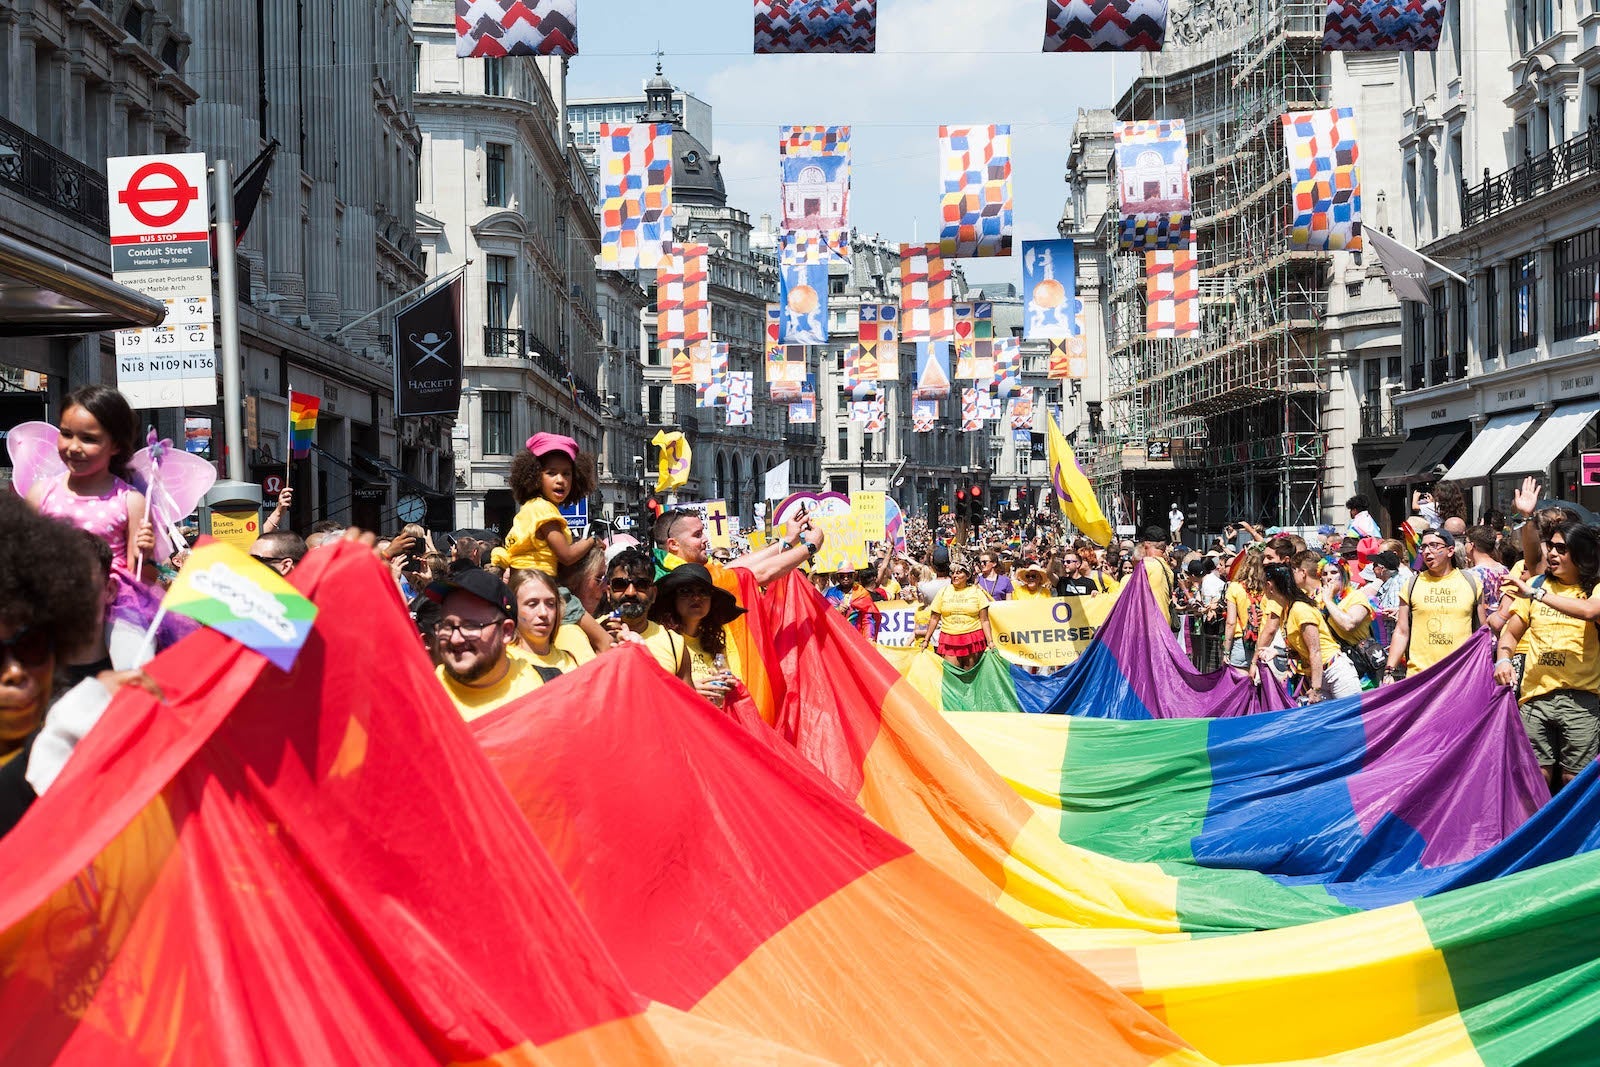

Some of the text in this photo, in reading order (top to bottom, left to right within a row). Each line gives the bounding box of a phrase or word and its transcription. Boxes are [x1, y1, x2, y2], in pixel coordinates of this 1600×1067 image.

[128, 247, 193, 257] Conduit Street
[188, 305, 203, 315] 94
[122, 335, 141, 346] 159
[154, 333, 175, 344] 453
[189, 332, 205, 342] C2
[121, 361, 145, 372] N18
[150, 359, 180, 371] N109
[183, 358, 213, 369] N136
[408, 379, 454, 389] HACKETT
[1430, 587, 1451, 595] FLAG
[1424, 595, 1457, 604] BEARER
[1018, 649, 1052, 660] Protect
[1538, 659, 1565, 667] LONDON
